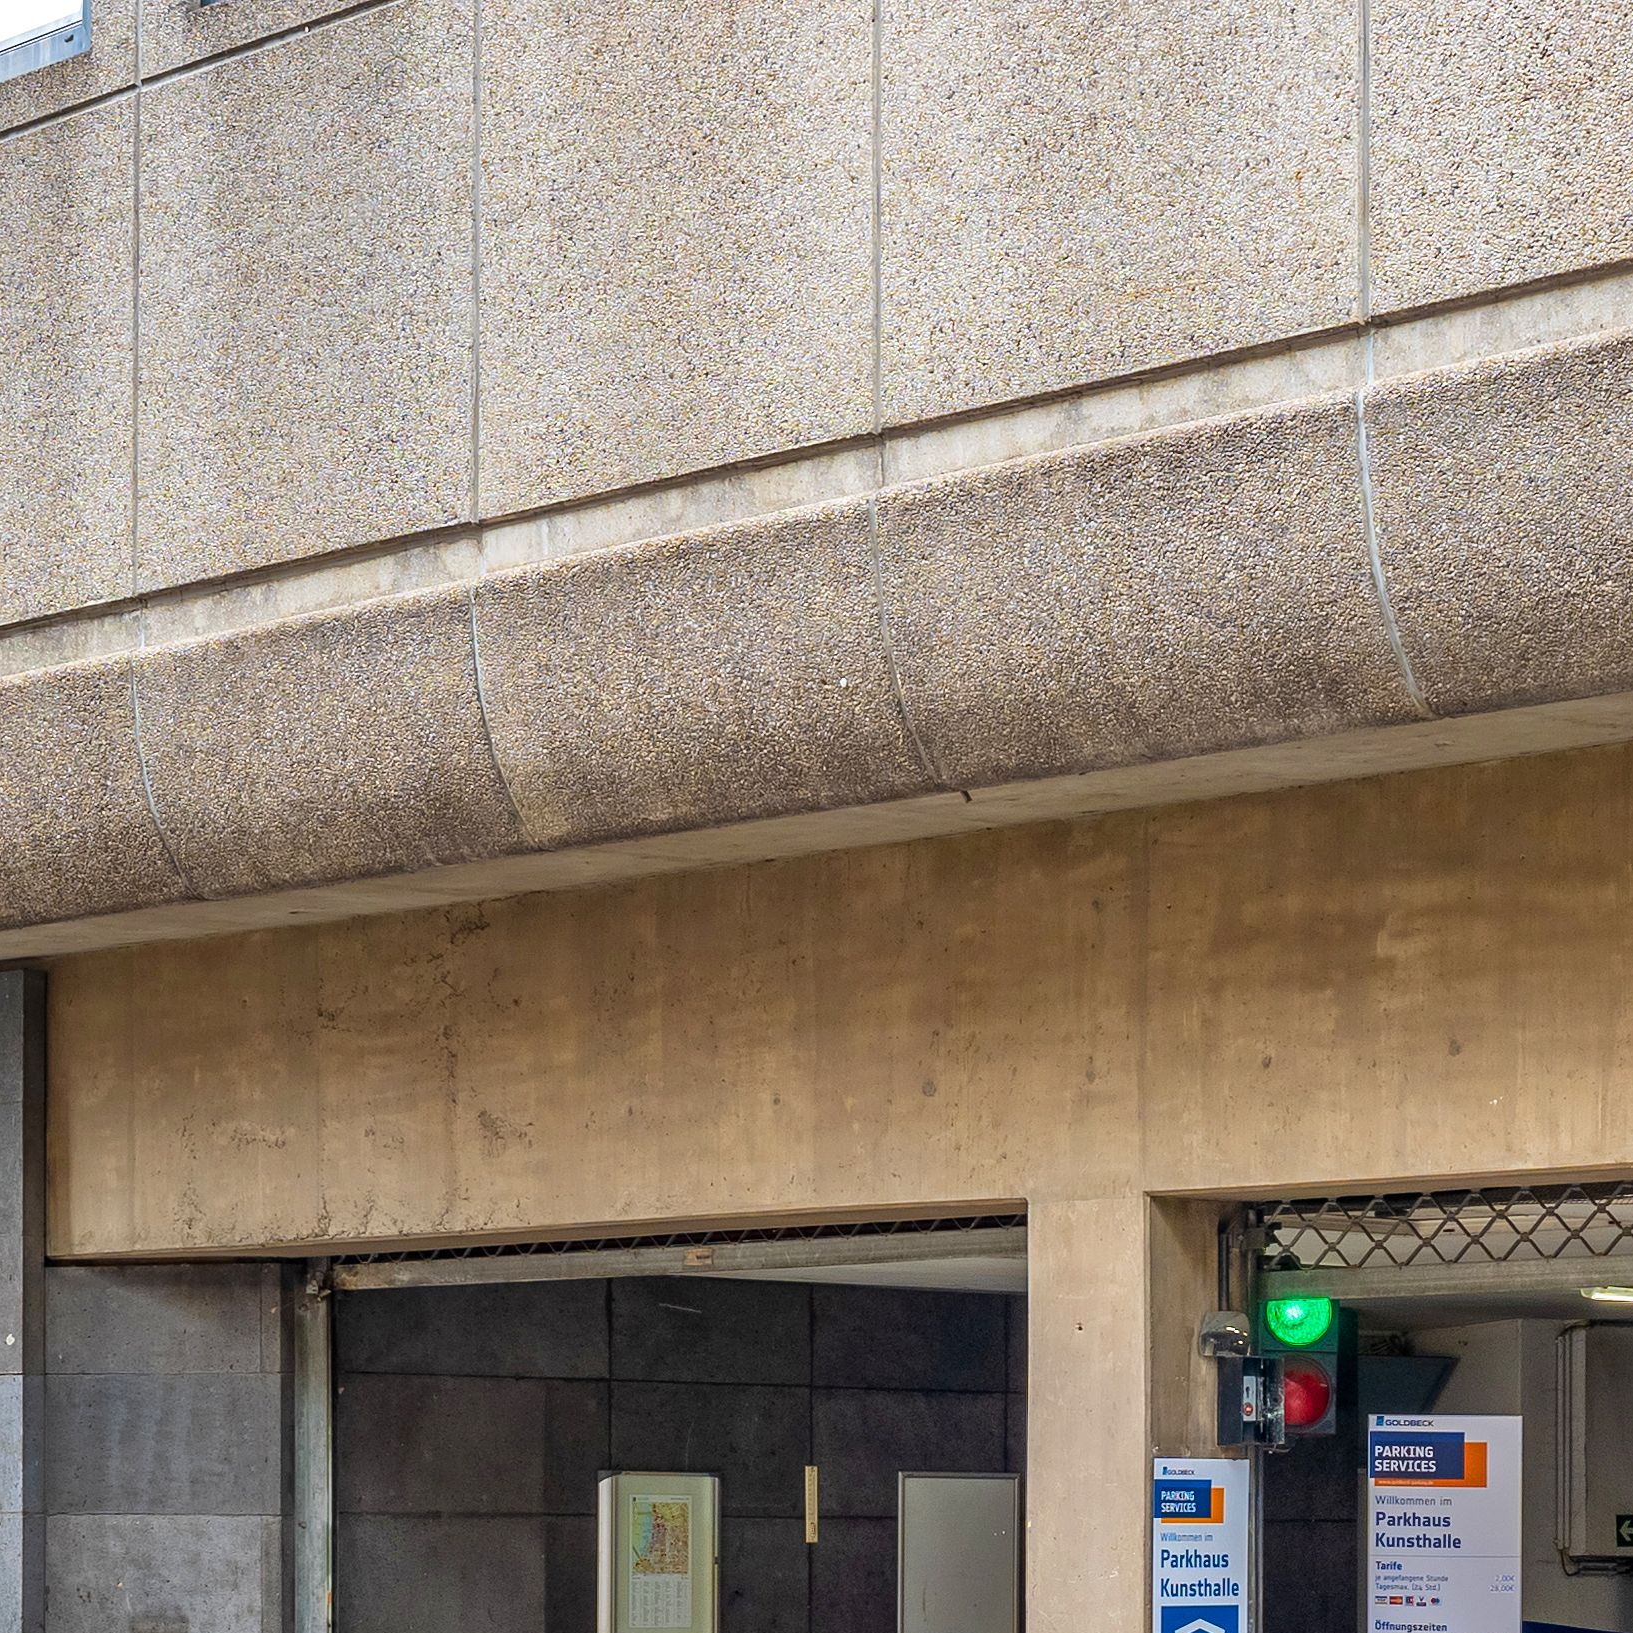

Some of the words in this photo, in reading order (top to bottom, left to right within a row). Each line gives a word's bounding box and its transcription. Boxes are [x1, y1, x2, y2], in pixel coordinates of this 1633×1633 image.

[1385, 1419, 1434, 1427] GOLDBECK
[1374, 1445, 1434, 1458] PARKING
[1374, 1459, 1436, 1472] SERVICES
[1160, 1491, 1195, 1501] PARKING
[1375, 1495, 1436, 1506] Willkommen
[1440, 1496, 1452, 1506] im
[1160, 1502, 1196, 1513] SERVICES
[1375, 1511, 1451, 1527] Parkhaus
[1160, 1532, 1202, 1541] Willkommen
[1204, 1533, 1213, 1541] im
[1375, 1532, 1461, 1549] Kunsthalle
[1160, 1549, 1229, 1568] Parkhaus
[1375, 1561, 1403, 1571] Tarife
[1160, 1578, 1240, 1597] Kunsthalle
[1375, 1620, 1448, 1633] Öffnungszeiten
